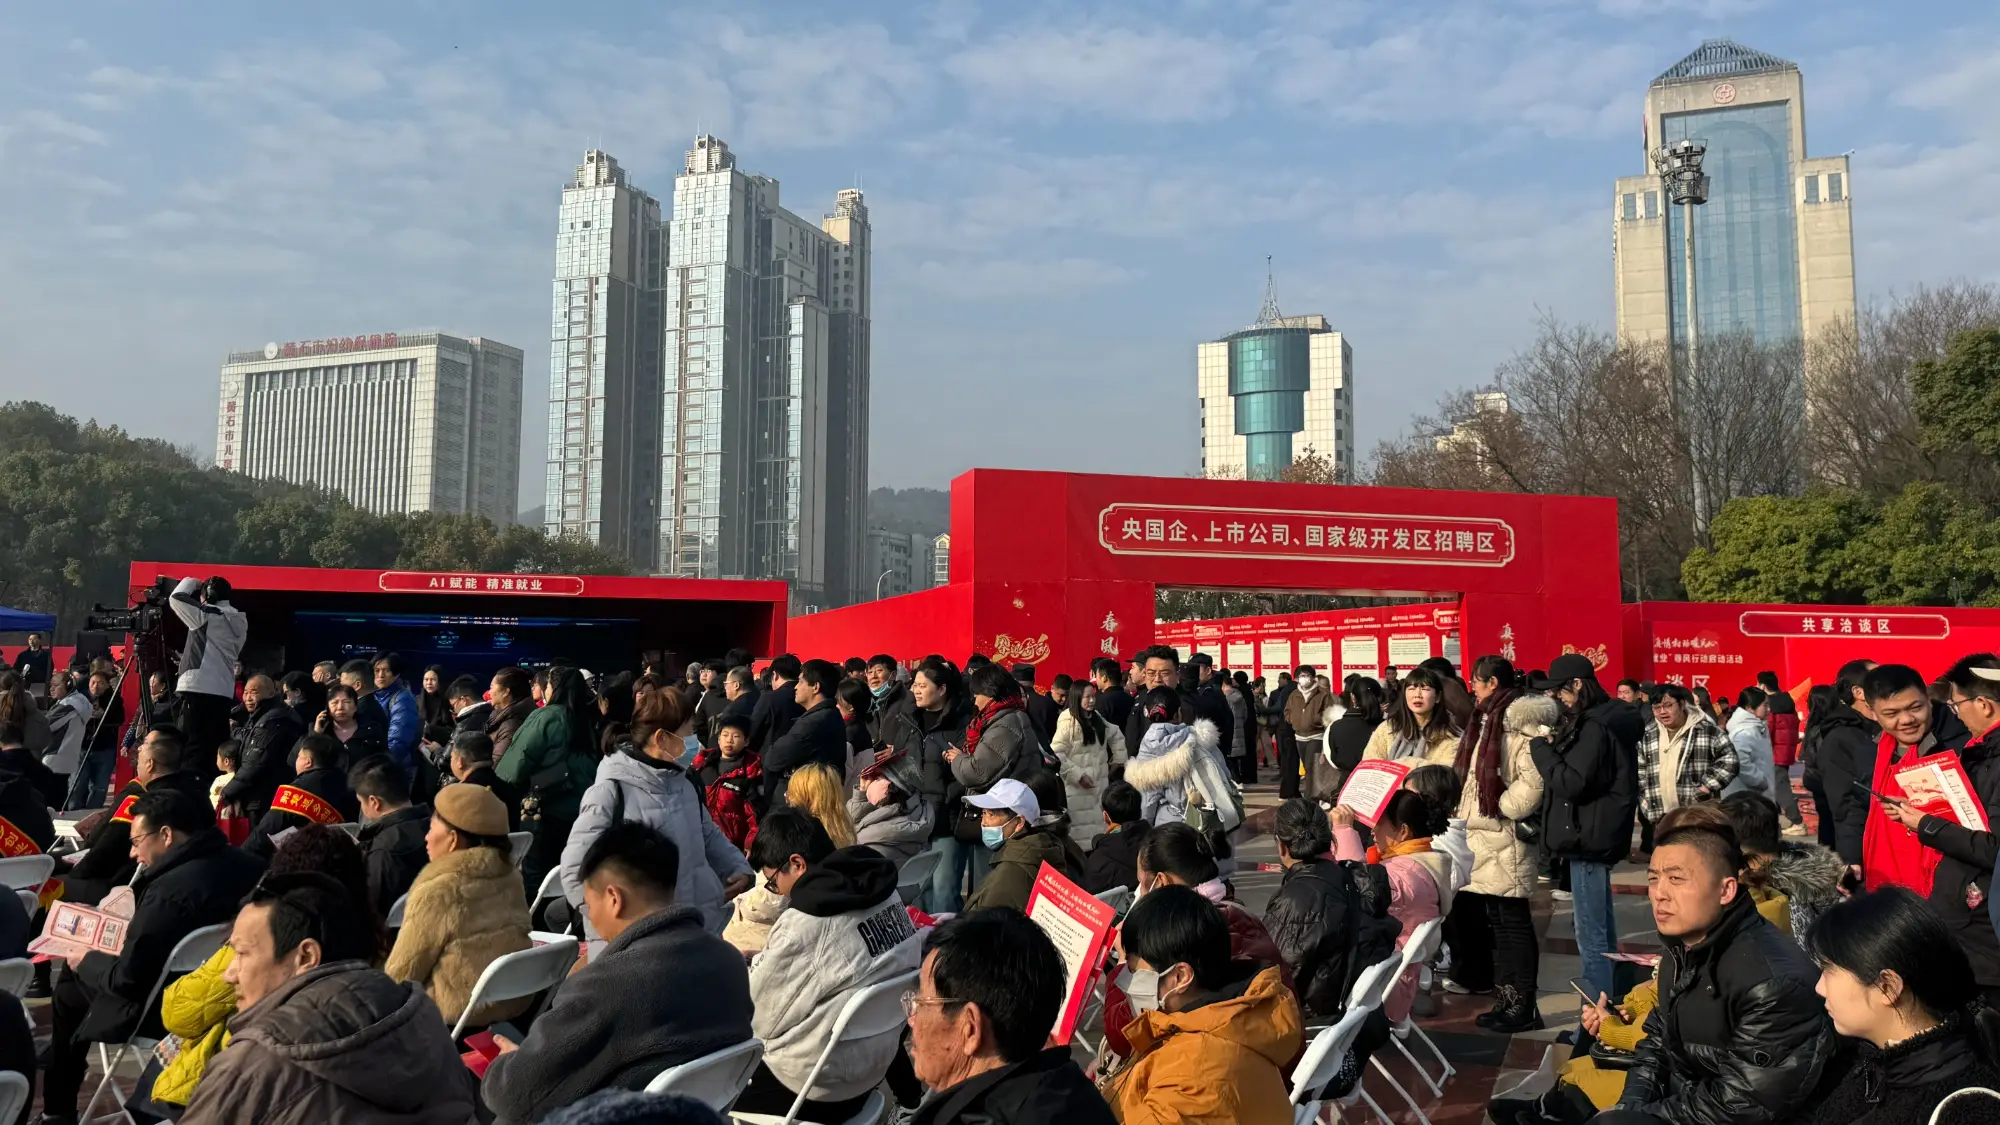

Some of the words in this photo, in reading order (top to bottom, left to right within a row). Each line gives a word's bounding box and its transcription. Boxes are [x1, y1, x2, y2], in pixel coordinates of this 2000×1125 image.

[1122, 517, 1495, 553] 央国企、上市公司、国家级开发区招聘区
[486, 578, 543, 590] 精准就业
[1802, 617, 1891, 634] 共享洽谈区
[279, 790, 339, 824] 荆楚返乡创业
[0, 825, 33, 857] 创业
